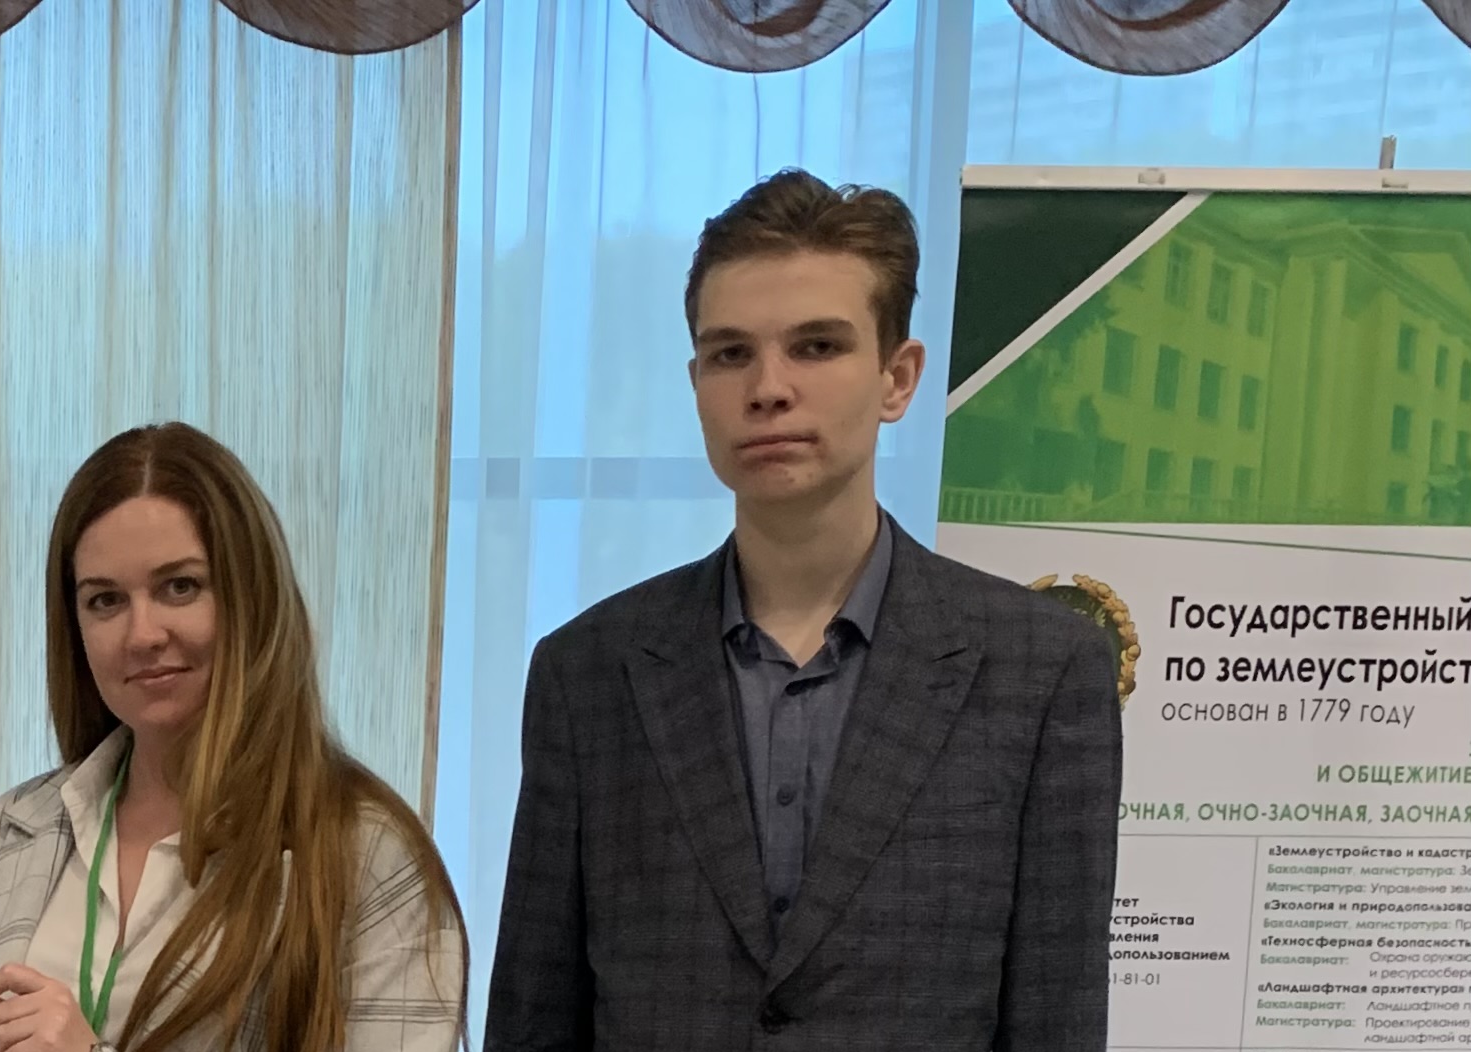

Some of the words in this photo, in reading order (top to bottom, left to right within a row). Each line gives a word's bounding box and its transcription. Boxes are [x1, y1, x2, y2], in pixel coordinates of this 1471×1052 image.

[1169, 595, 1471, 638] Государственный
[1165, 656, 1206, 682] по
[1215, 649, 1471, 691] землеустройст
[1161, 702, 1269, 722] основан
[1277, 703, 1288, 722] в
[1300, 698, 1351, 722] 1779
[1359, 704, 1416, 729] году
[1316, 764, 1331, 783] И
[1337, 764, 1471, 786] ОБЩЕЖИТИЕ
[1197, 802, 1373, 824] ОЧНО-ЗАОЧНАЯ,
[1380, 804, 1471, 823] ЗАОЧНАЯ
[1108, 950, 1230, 961] опользованием
